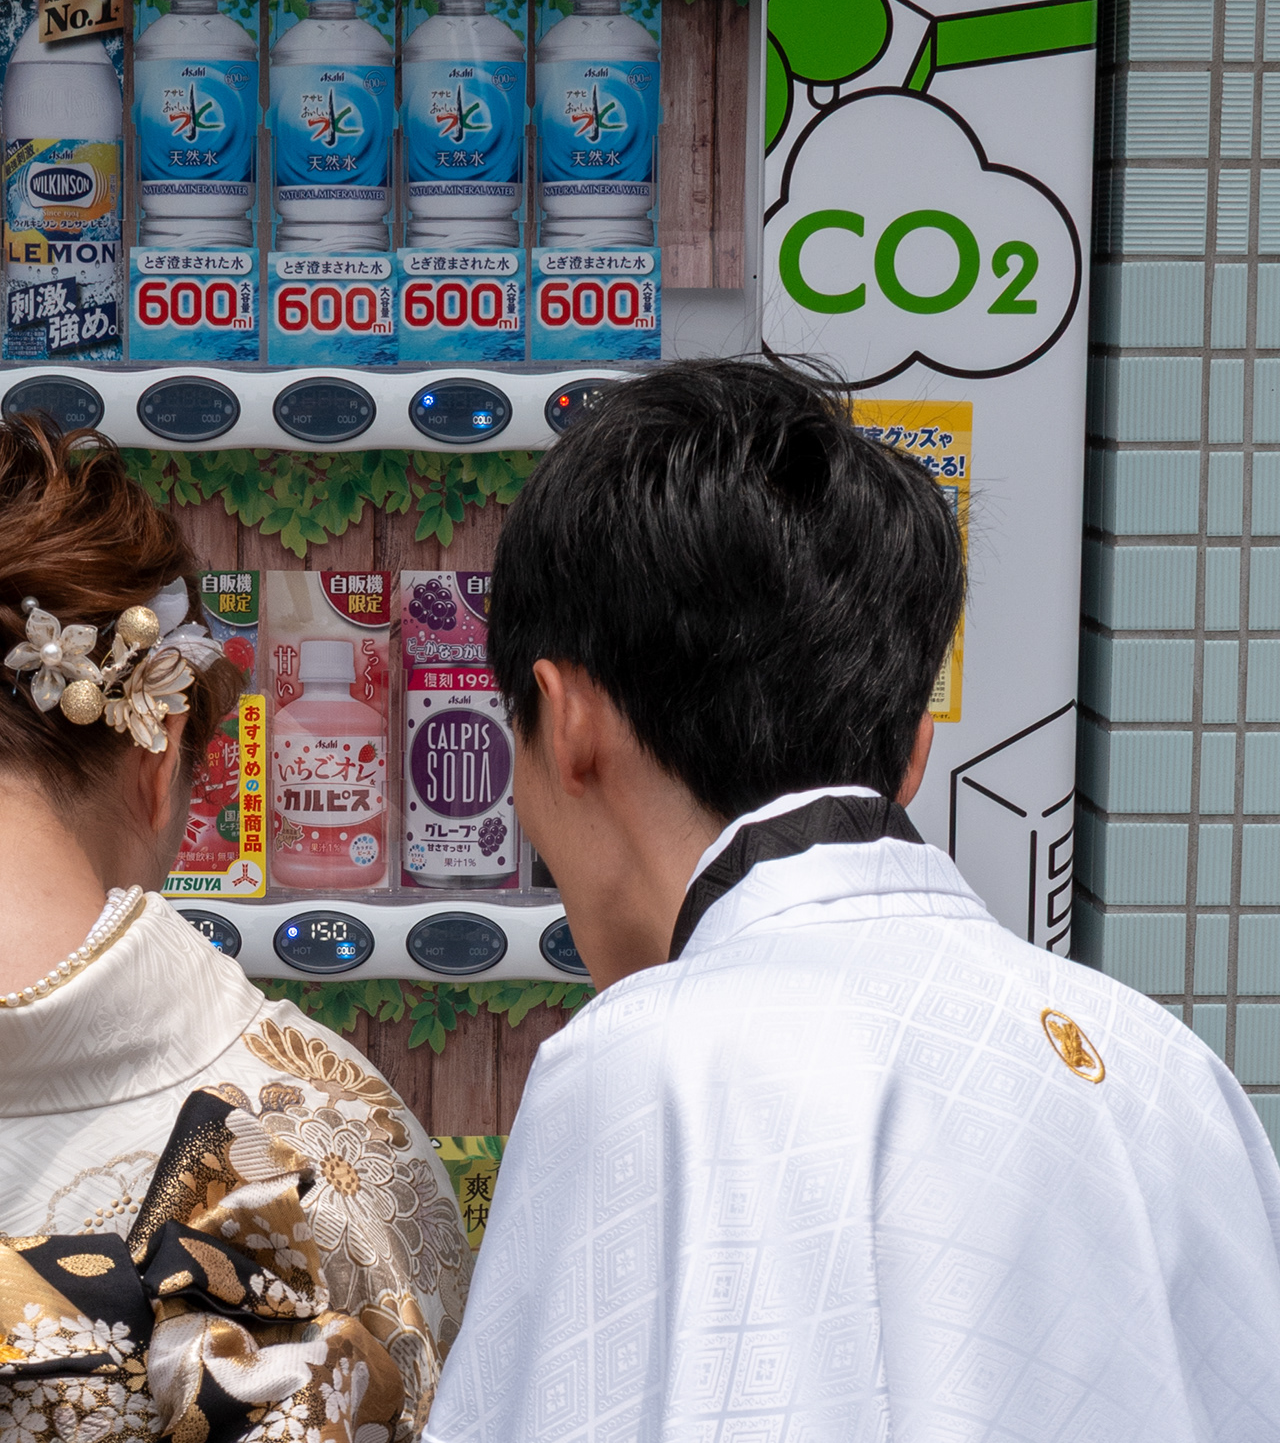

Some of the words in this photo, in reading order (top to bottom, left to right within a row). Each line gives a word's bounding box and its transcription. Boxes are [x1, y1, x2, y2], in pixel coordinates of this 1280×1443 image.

[163, 88, 184, 98] アサヒ
[168, 149, 218, 167] 天然水
[142, 184, 177, 196] NATURAL
[178, 184, 216, 196] MINERAL
[219, 184, 248, 196] WATER
[144, 255, 245, 271] とぎ澄まされた水
[778, 208, 1040, 316] CO2
[240, 282, 251, 315] 大容量
[201, 574, 253, 594] 自販機
[219, 595, 252, 613] 限定
[274, 646, 297, 698] 甘い
[362, 638, 380, 701] こっくり
[424, 672, 453, 688] 復刻
[427, 723, 490, 752] CALPIS
[243, 704, 263, 854] おすすめの新商品
[278, 754, 375, 783] いちごオレ
[427, 755, 492, 804] SODA
[424, 823, 477, 839] グレープ
[427, 842, 472, 853] 甘さすっきり
[462, 1172, 492, 1234] 爽快
